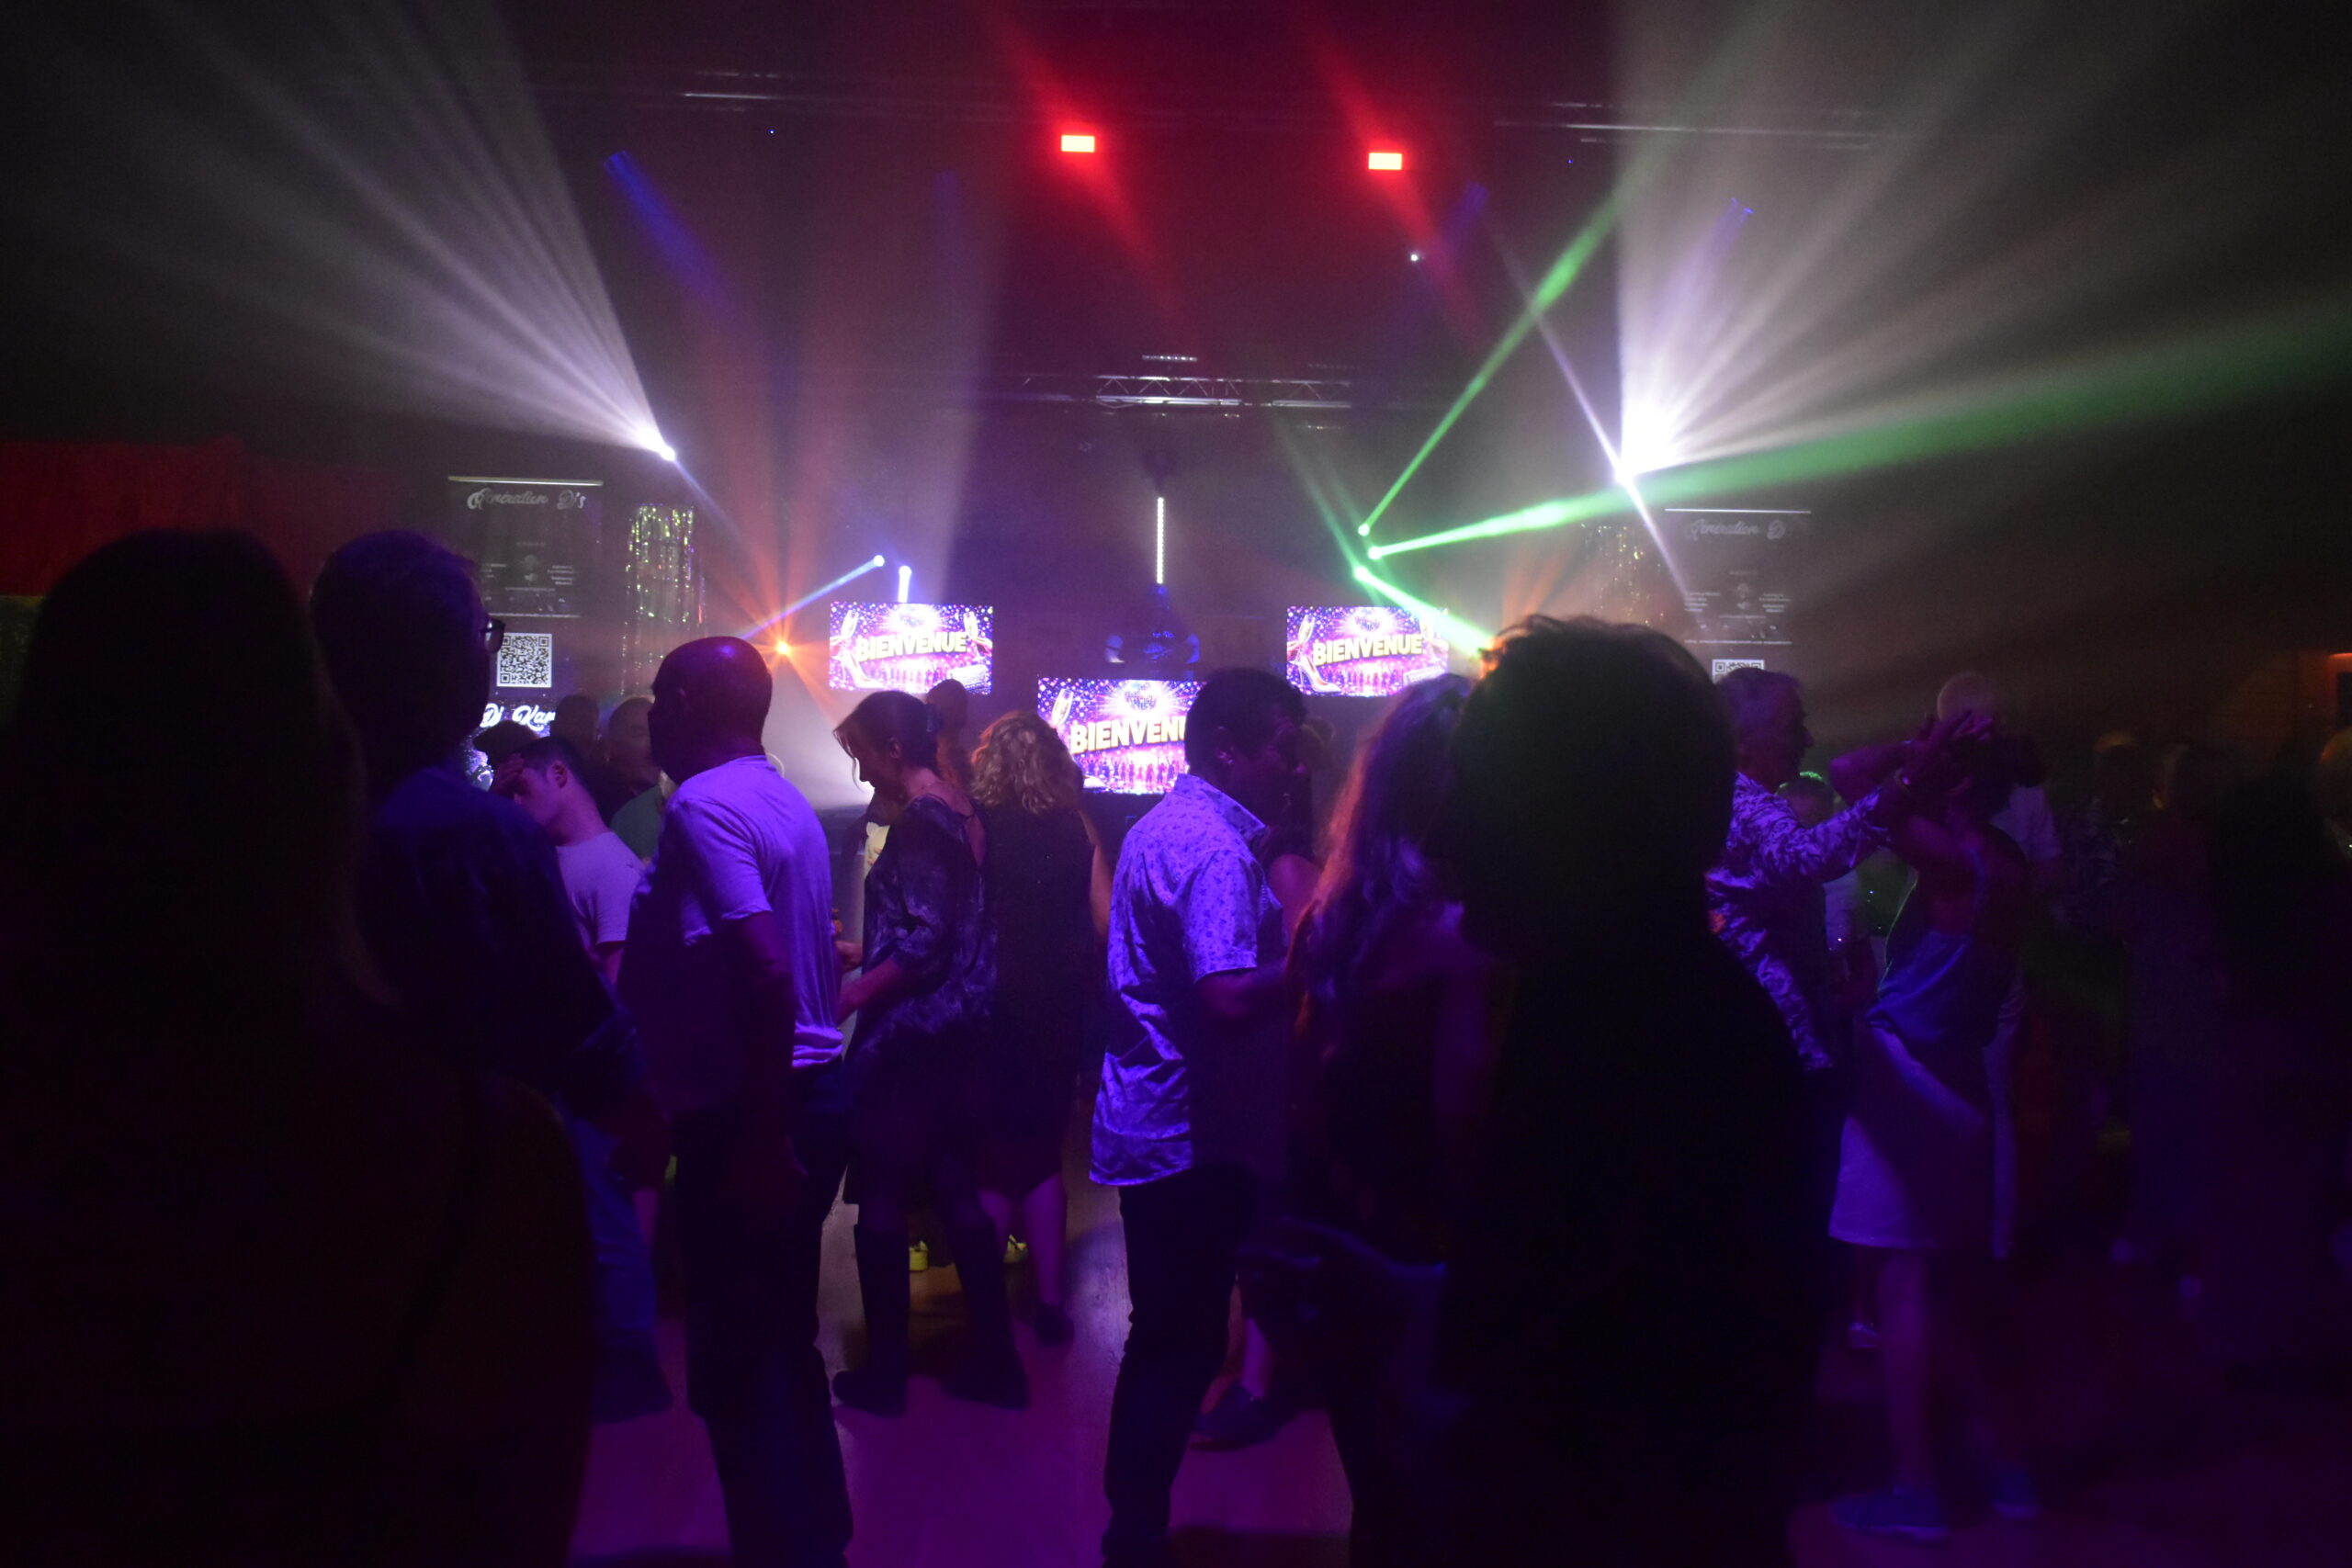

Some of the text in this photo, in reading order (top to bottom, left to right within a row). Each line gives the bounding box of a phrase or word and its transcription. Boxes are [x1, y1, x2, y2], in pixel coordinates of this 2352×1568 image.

[855, 631, 967, 662] BIENVENUE
[1312, 633, 1424, 667] BIENVENUE
[1069, 716, 1187, 755] BIENVEN
